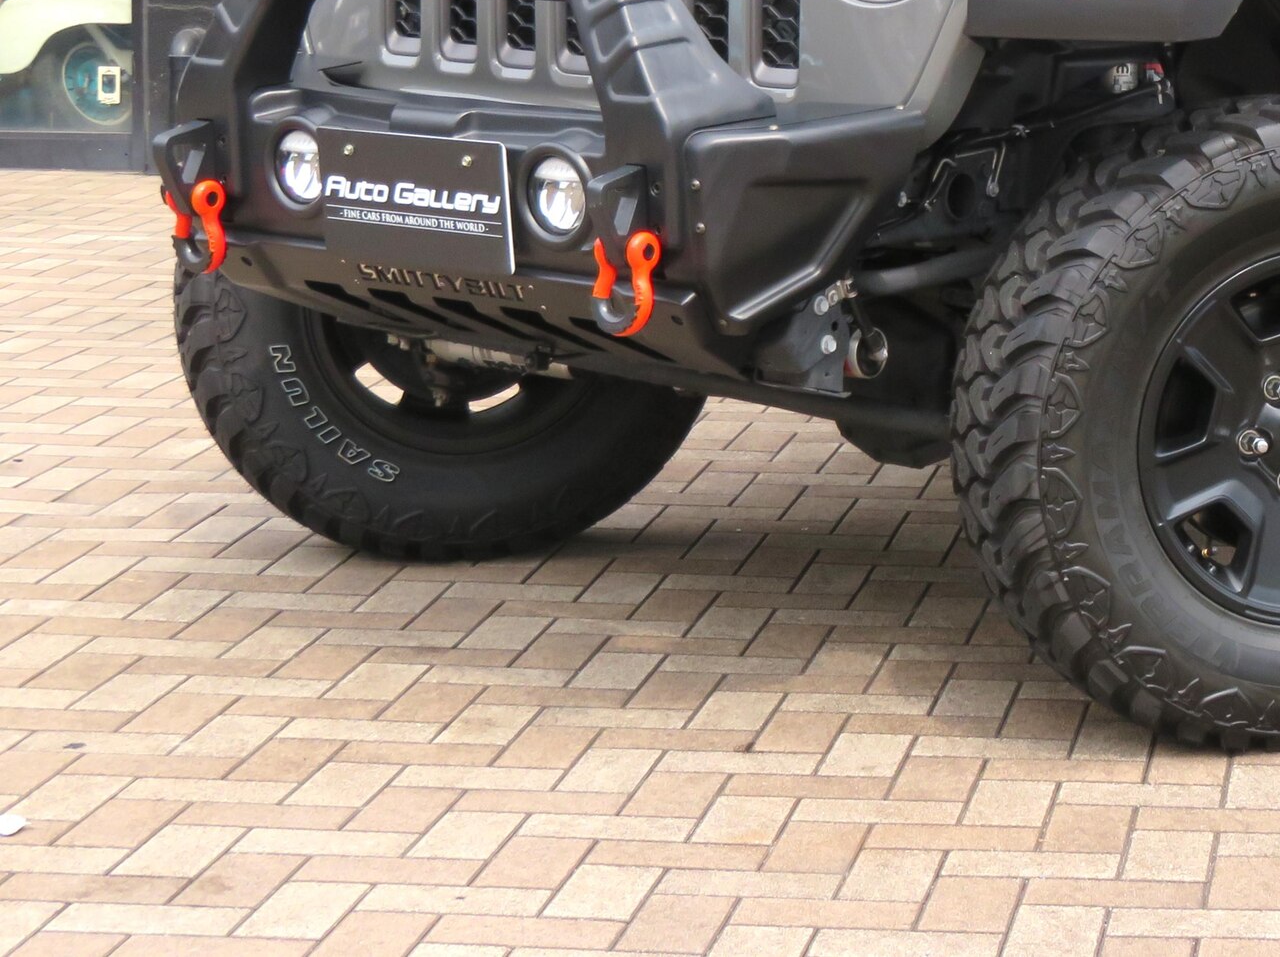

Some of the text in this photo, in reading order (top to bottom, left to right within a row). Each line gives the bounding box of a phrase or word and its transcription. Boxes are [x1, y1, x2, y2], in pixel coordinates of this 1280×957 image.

[325, 175, 501, 215] Auto Gallery
[362, 210, 380, 222] CARS
[382, 213, 403, 224] FROM
[404, 216, 438, 228] AROUND
[439, 220, 455, 231] THE
[269, 344, 400, 482] SAILUN
